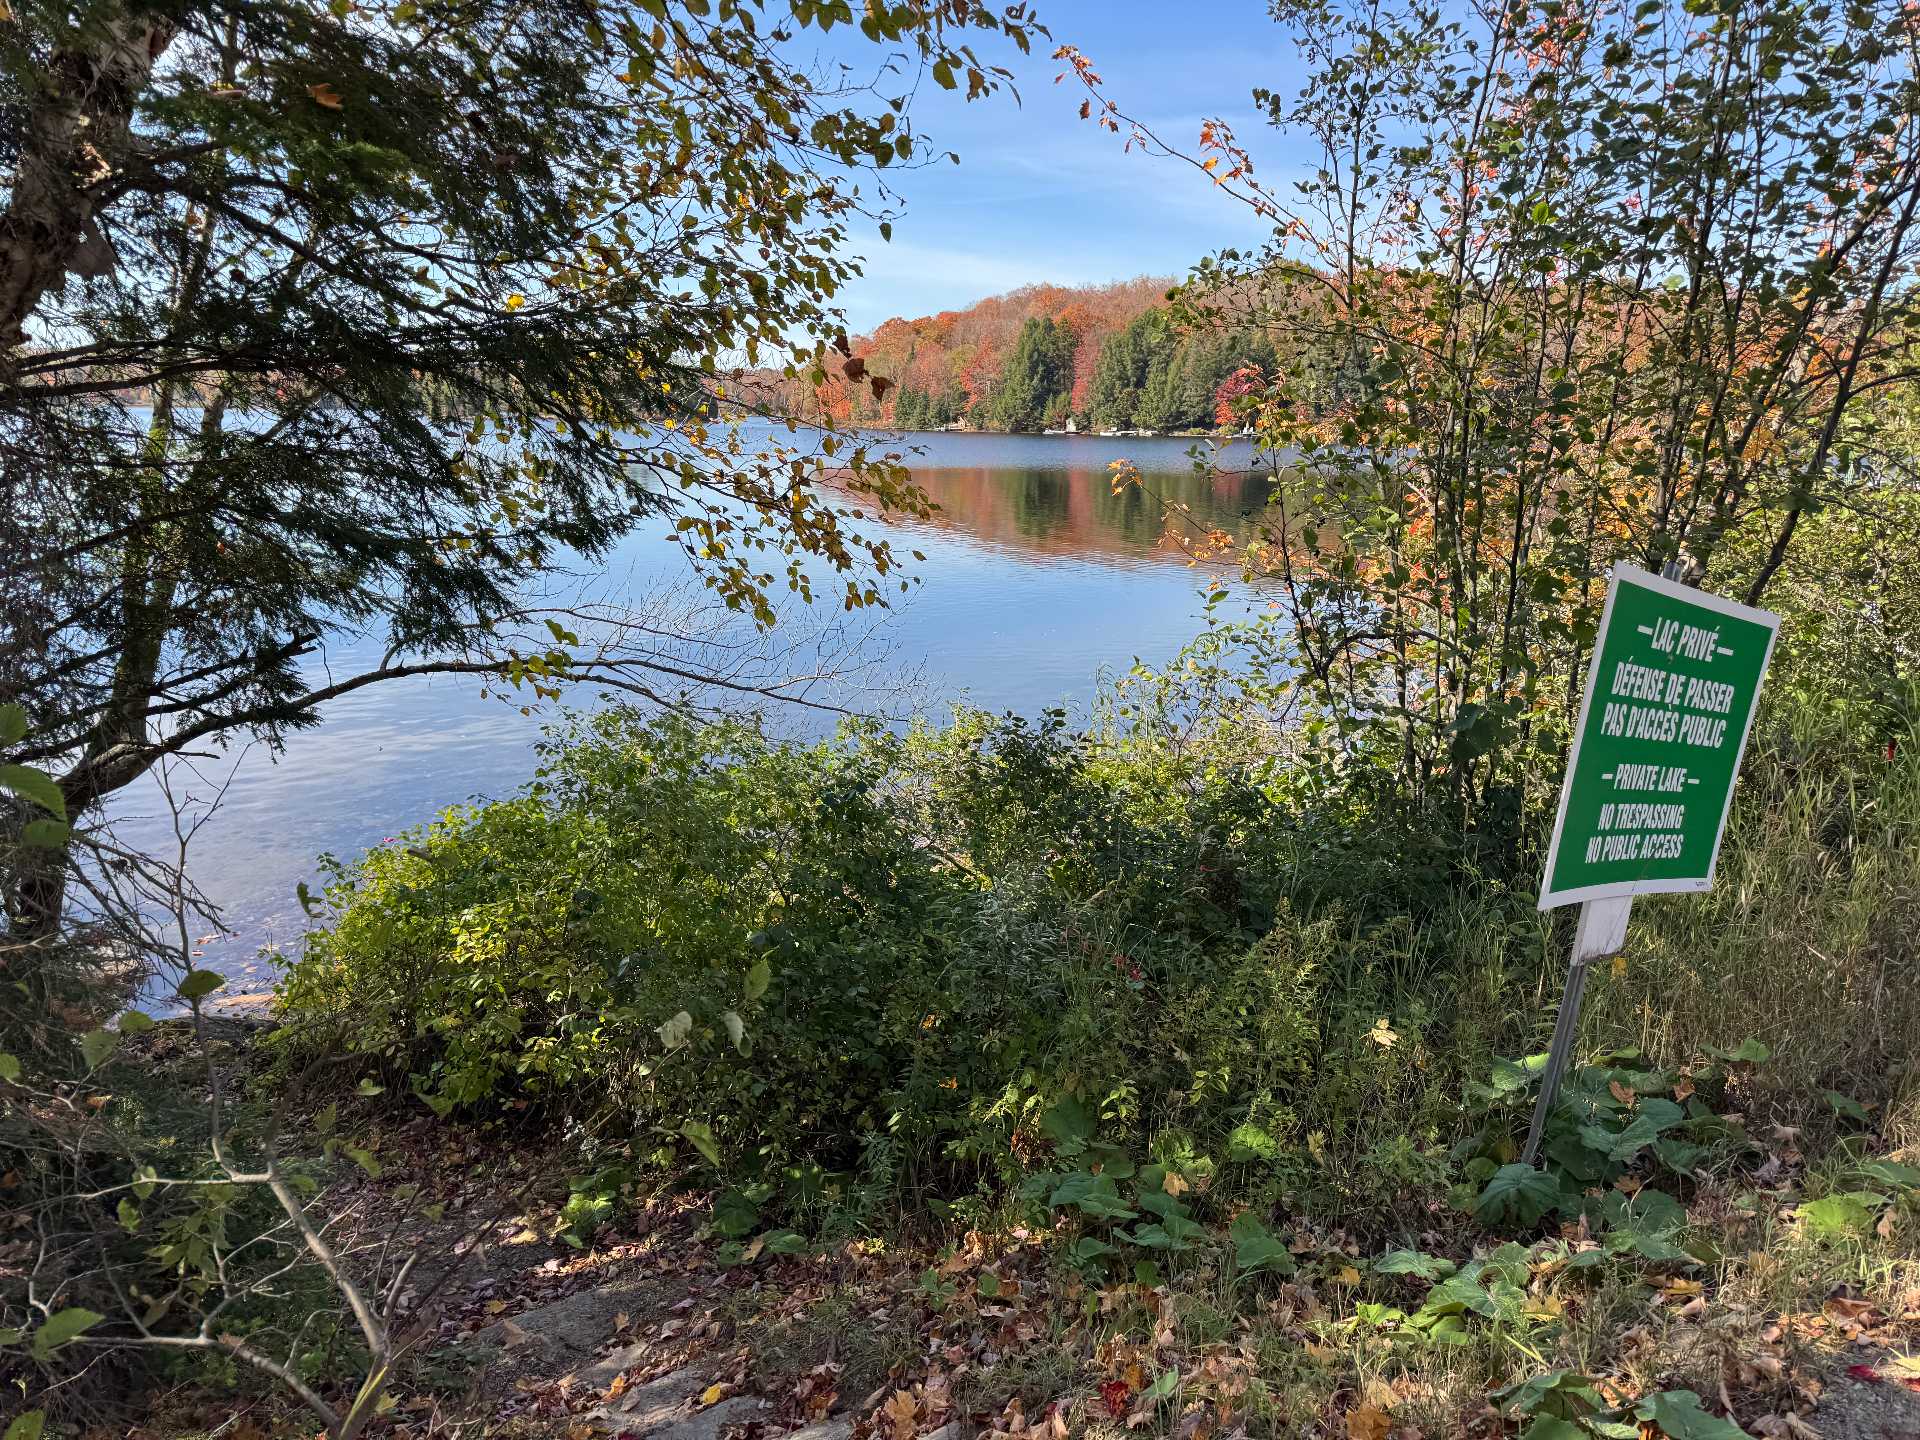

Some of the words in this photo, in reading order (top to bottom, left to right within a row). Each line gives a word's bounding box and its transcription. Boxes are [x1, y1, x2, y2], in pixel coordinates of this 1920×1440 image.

[1651, 617, 1679, 653] LAC
[1676, 625, 1720, 662] PRIVÉ
[1611, 656, 1666, 702] DÉFENSE
[1664, 673, 1686, 705] DE
[1684, 677, 1735, 714] PASSER
[1600, 702, 1627, 736] PAS
[1625, 703, 1680, 743] D'ACCÈS
[1678, 714, 1727, 749] PUBLIC
[1613, 764, 1660, 791] PRIVATE
[1657, 767, 1687, 792] LAKE
[1597, 803, 1615, 831] NO
[1615, 803, 1685, 829] TRESPASSING
[1585, 837, 1602, 864] NO
[1601, 834, 1641, 862] PUBLIC
[1640, 834, 1684, 859] ACCESS
